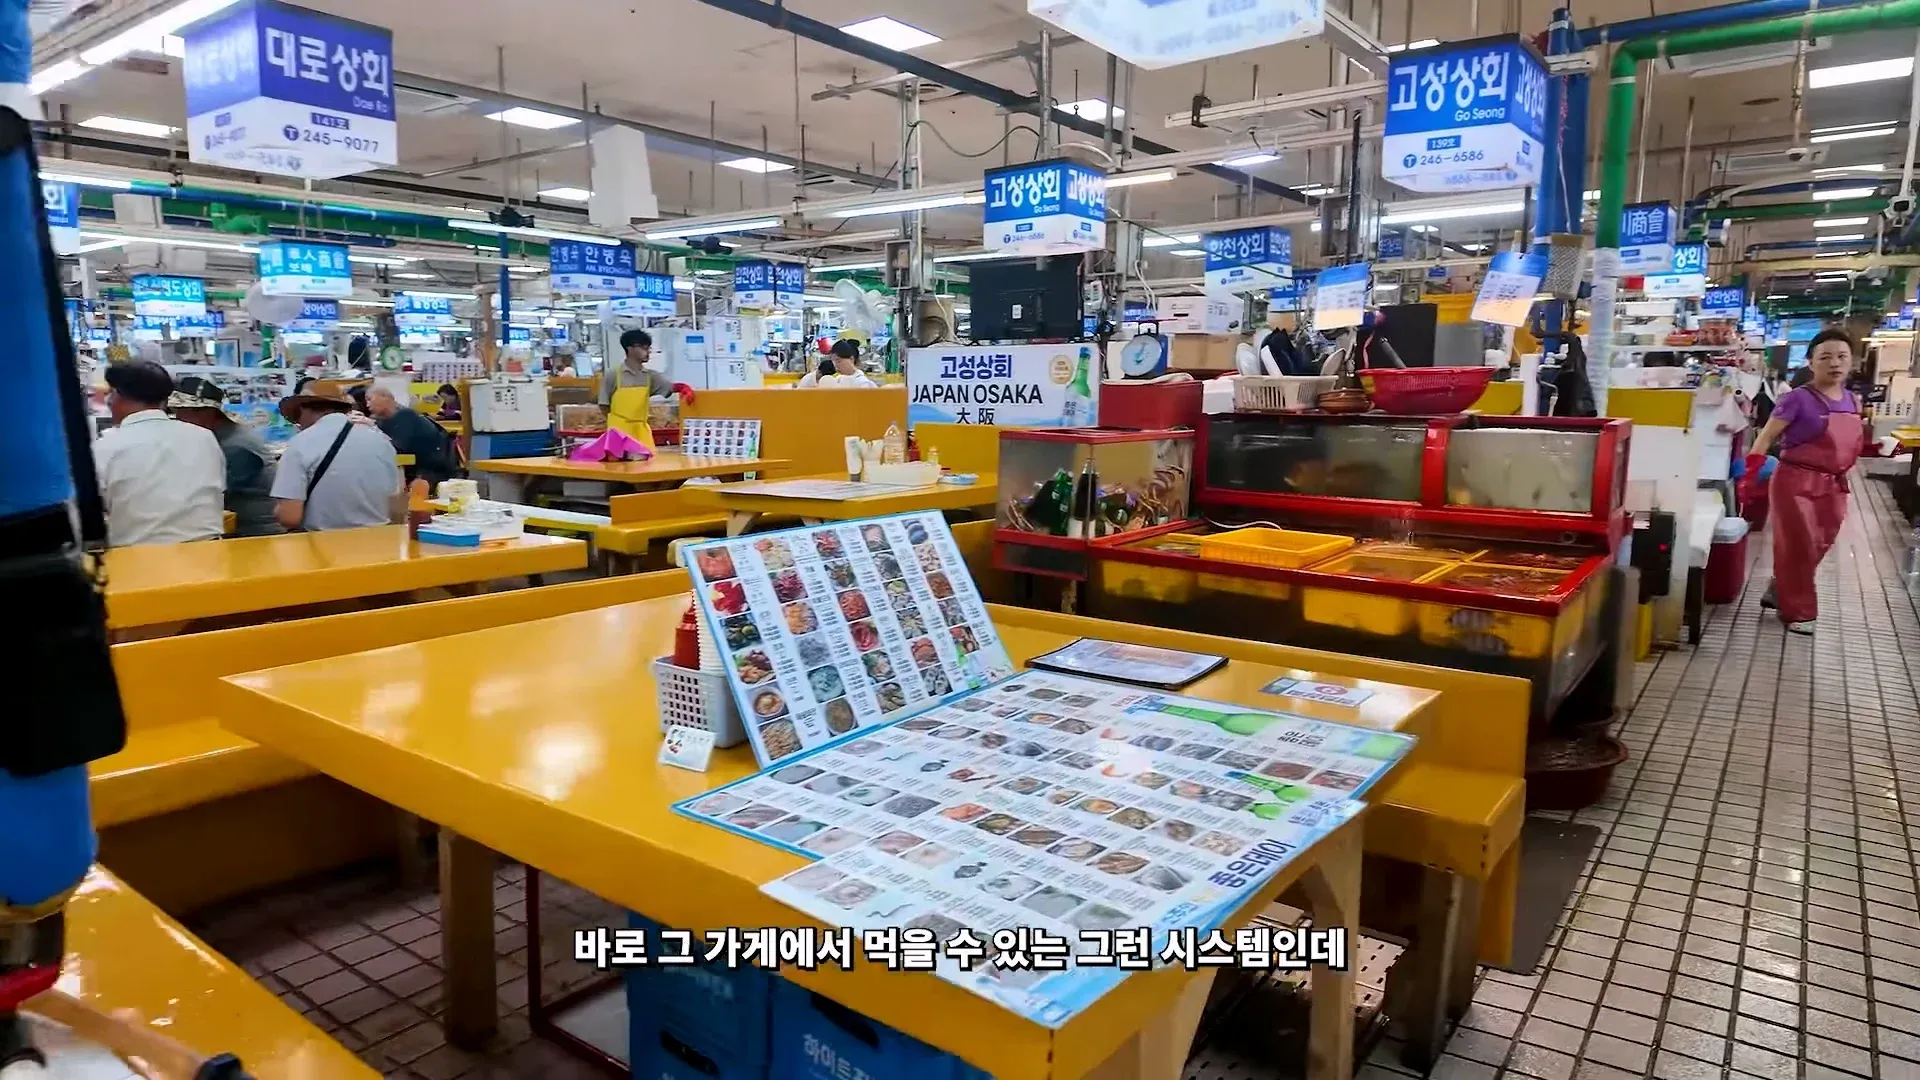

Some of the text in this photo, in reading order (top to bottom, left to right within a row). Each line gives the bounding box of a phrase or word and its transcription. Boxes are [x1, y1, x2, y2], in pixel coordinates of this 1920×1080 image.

[265, 27, 389, 98] 대로상회
[1391, 51, 1510, 112] 고성상회
[1455, 106, 1505, 122] Go Seong
[303, 129, 379, 153] 245-9077
[1420, 149, 1485, 165] 246-6586
[990, 169, 1061, 208] 고성상회
[941, 354, 1012, 380] 고성상회
[912, 384, 1043, 404] JAPAN OSAKA
